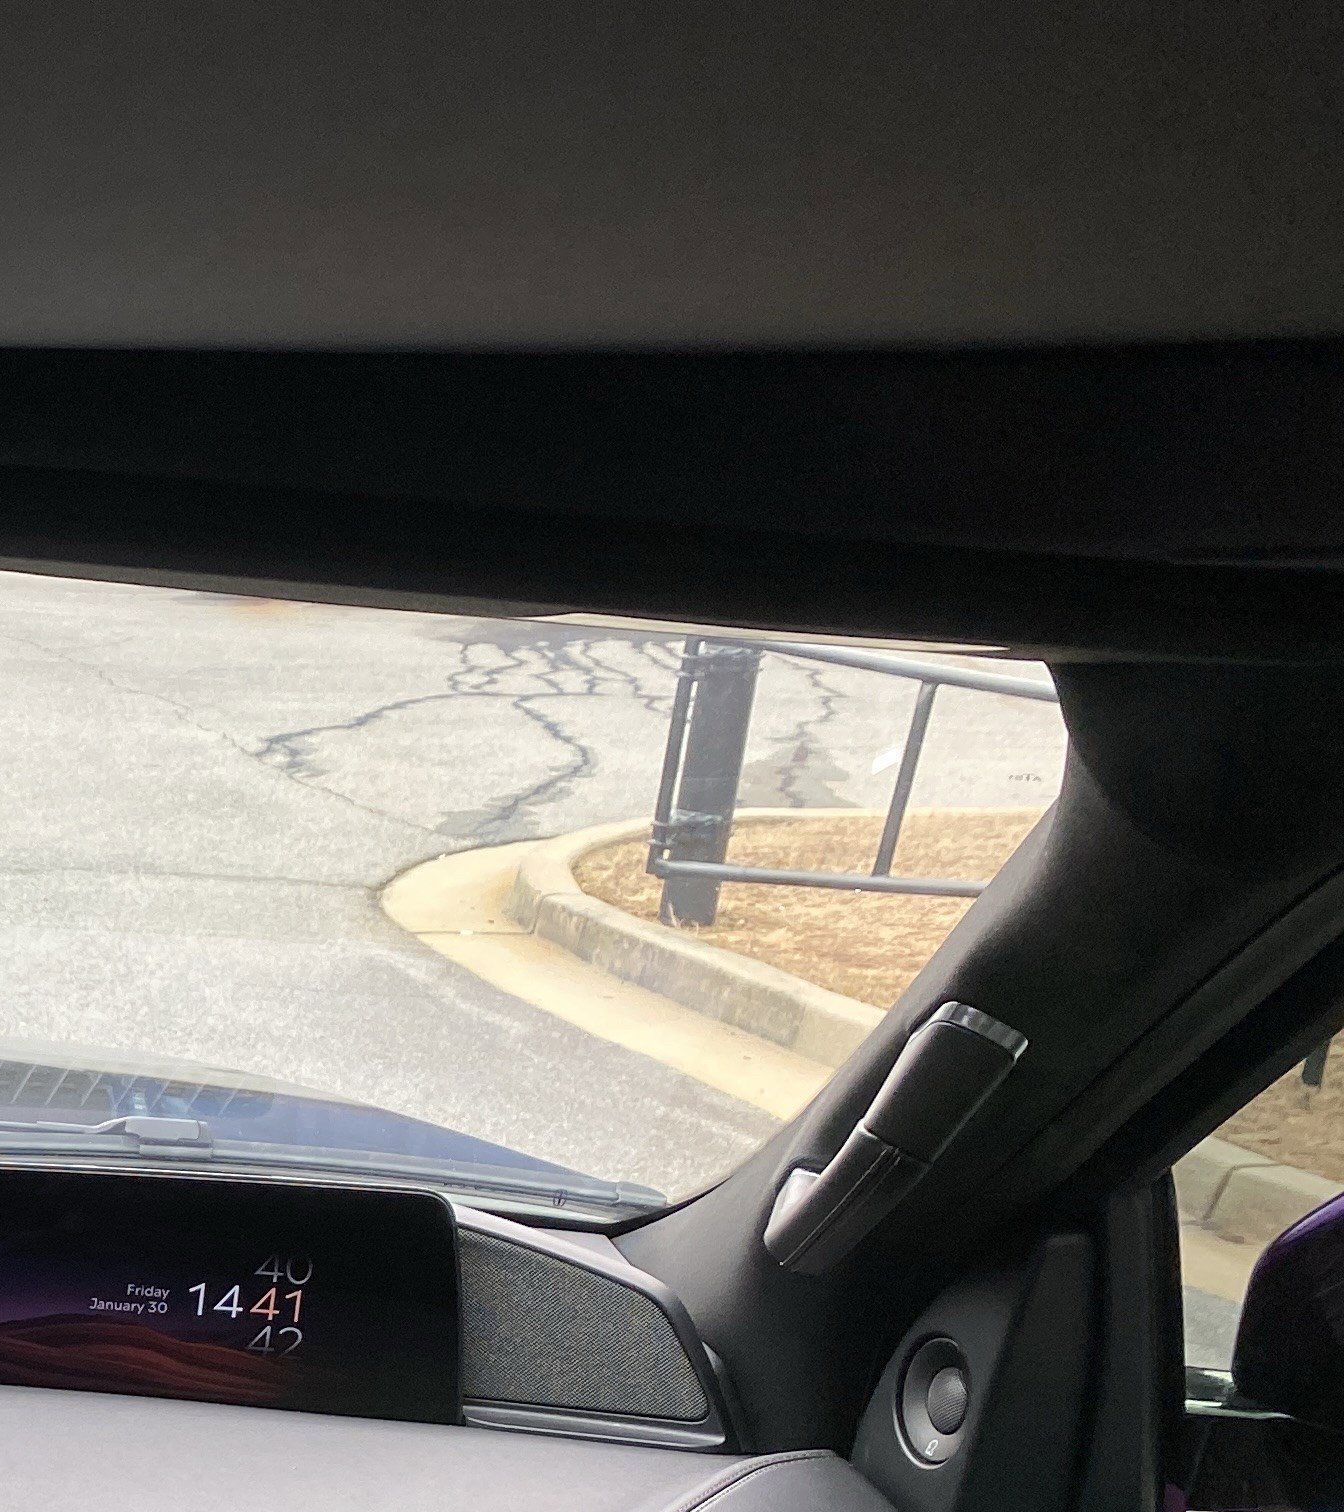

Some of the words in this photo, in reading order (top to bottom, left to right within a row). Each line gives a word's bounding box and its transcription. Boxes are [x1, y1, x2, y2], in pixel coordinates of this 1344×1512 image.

[254, 1254, 313, 1285] 40
[127, 1283, 170, 1300] Friday
[89, 1297, 145, 1314] January
[148, 1301, 168, 1314] 30
